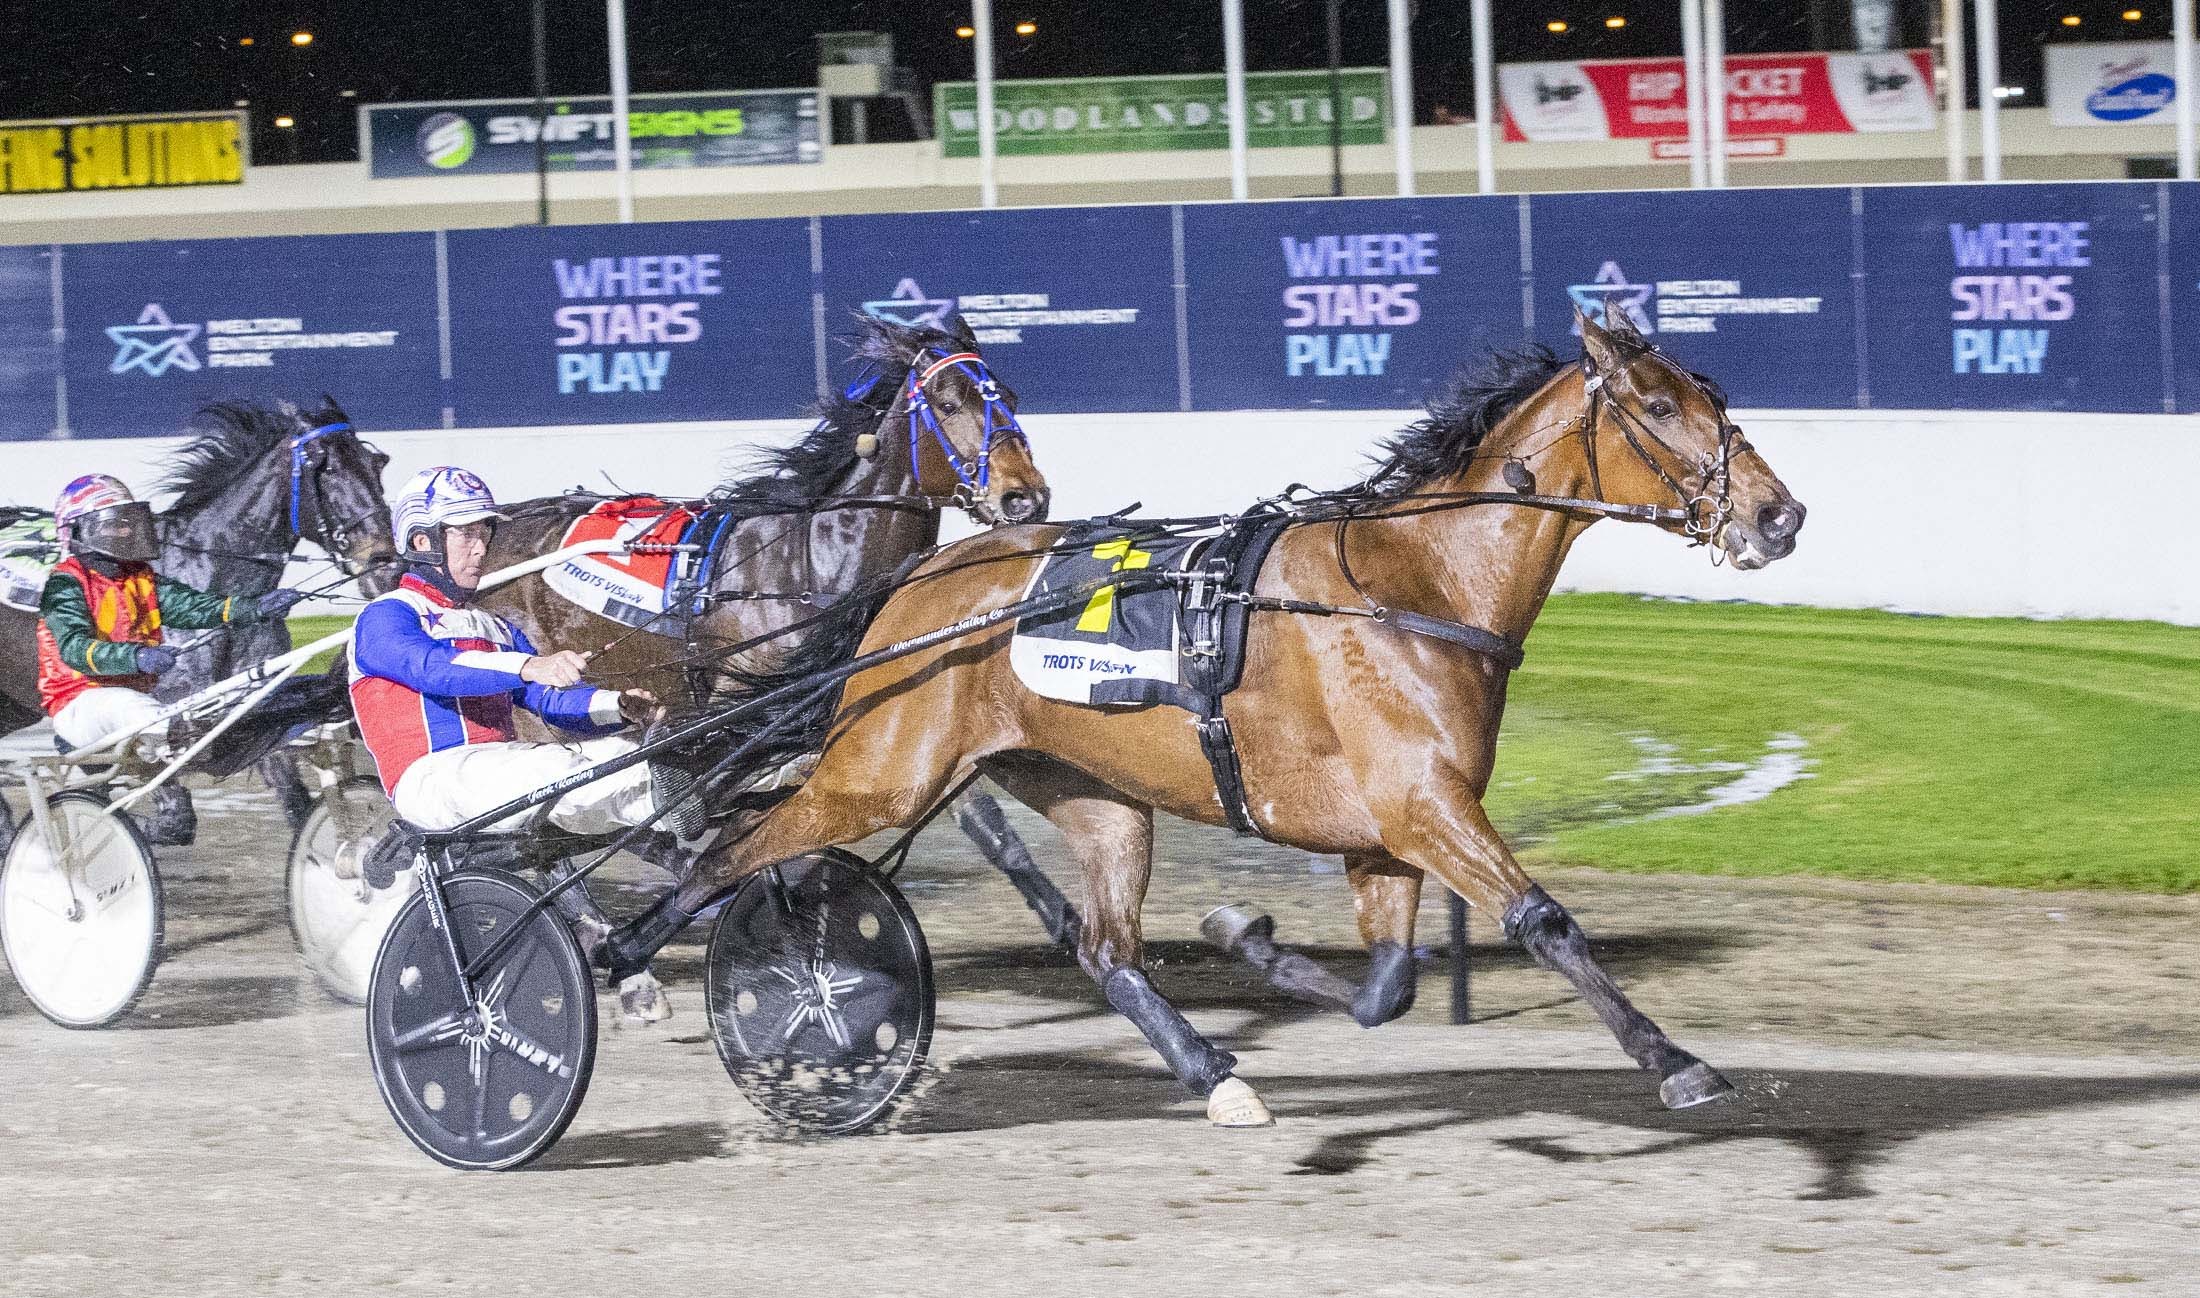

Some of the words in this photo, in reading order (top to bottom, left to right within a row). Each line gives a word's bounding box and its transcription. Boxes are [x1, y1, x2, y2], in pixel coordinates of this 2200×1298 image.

[1724, 68, 1806, 97] CKET
[1280, 233, 1441, 278] WHERE
[1950, 222, 2092, 267] WHERE
[553, 254, 724, 298] WHERE
[1950, 275, 2075, 320] STARS
[554, 302, 703, 346] STARS
[1283, 283, 1421, 327] STARS
[557, 351, 671, 394] PLAY
[1286, 333, 1392, 376] PLAY
[1953, 328, 2050, 374] PLAY
[563, 562, 602, 587] TROTS
[1042, 654, 1084, 670] TROTS
